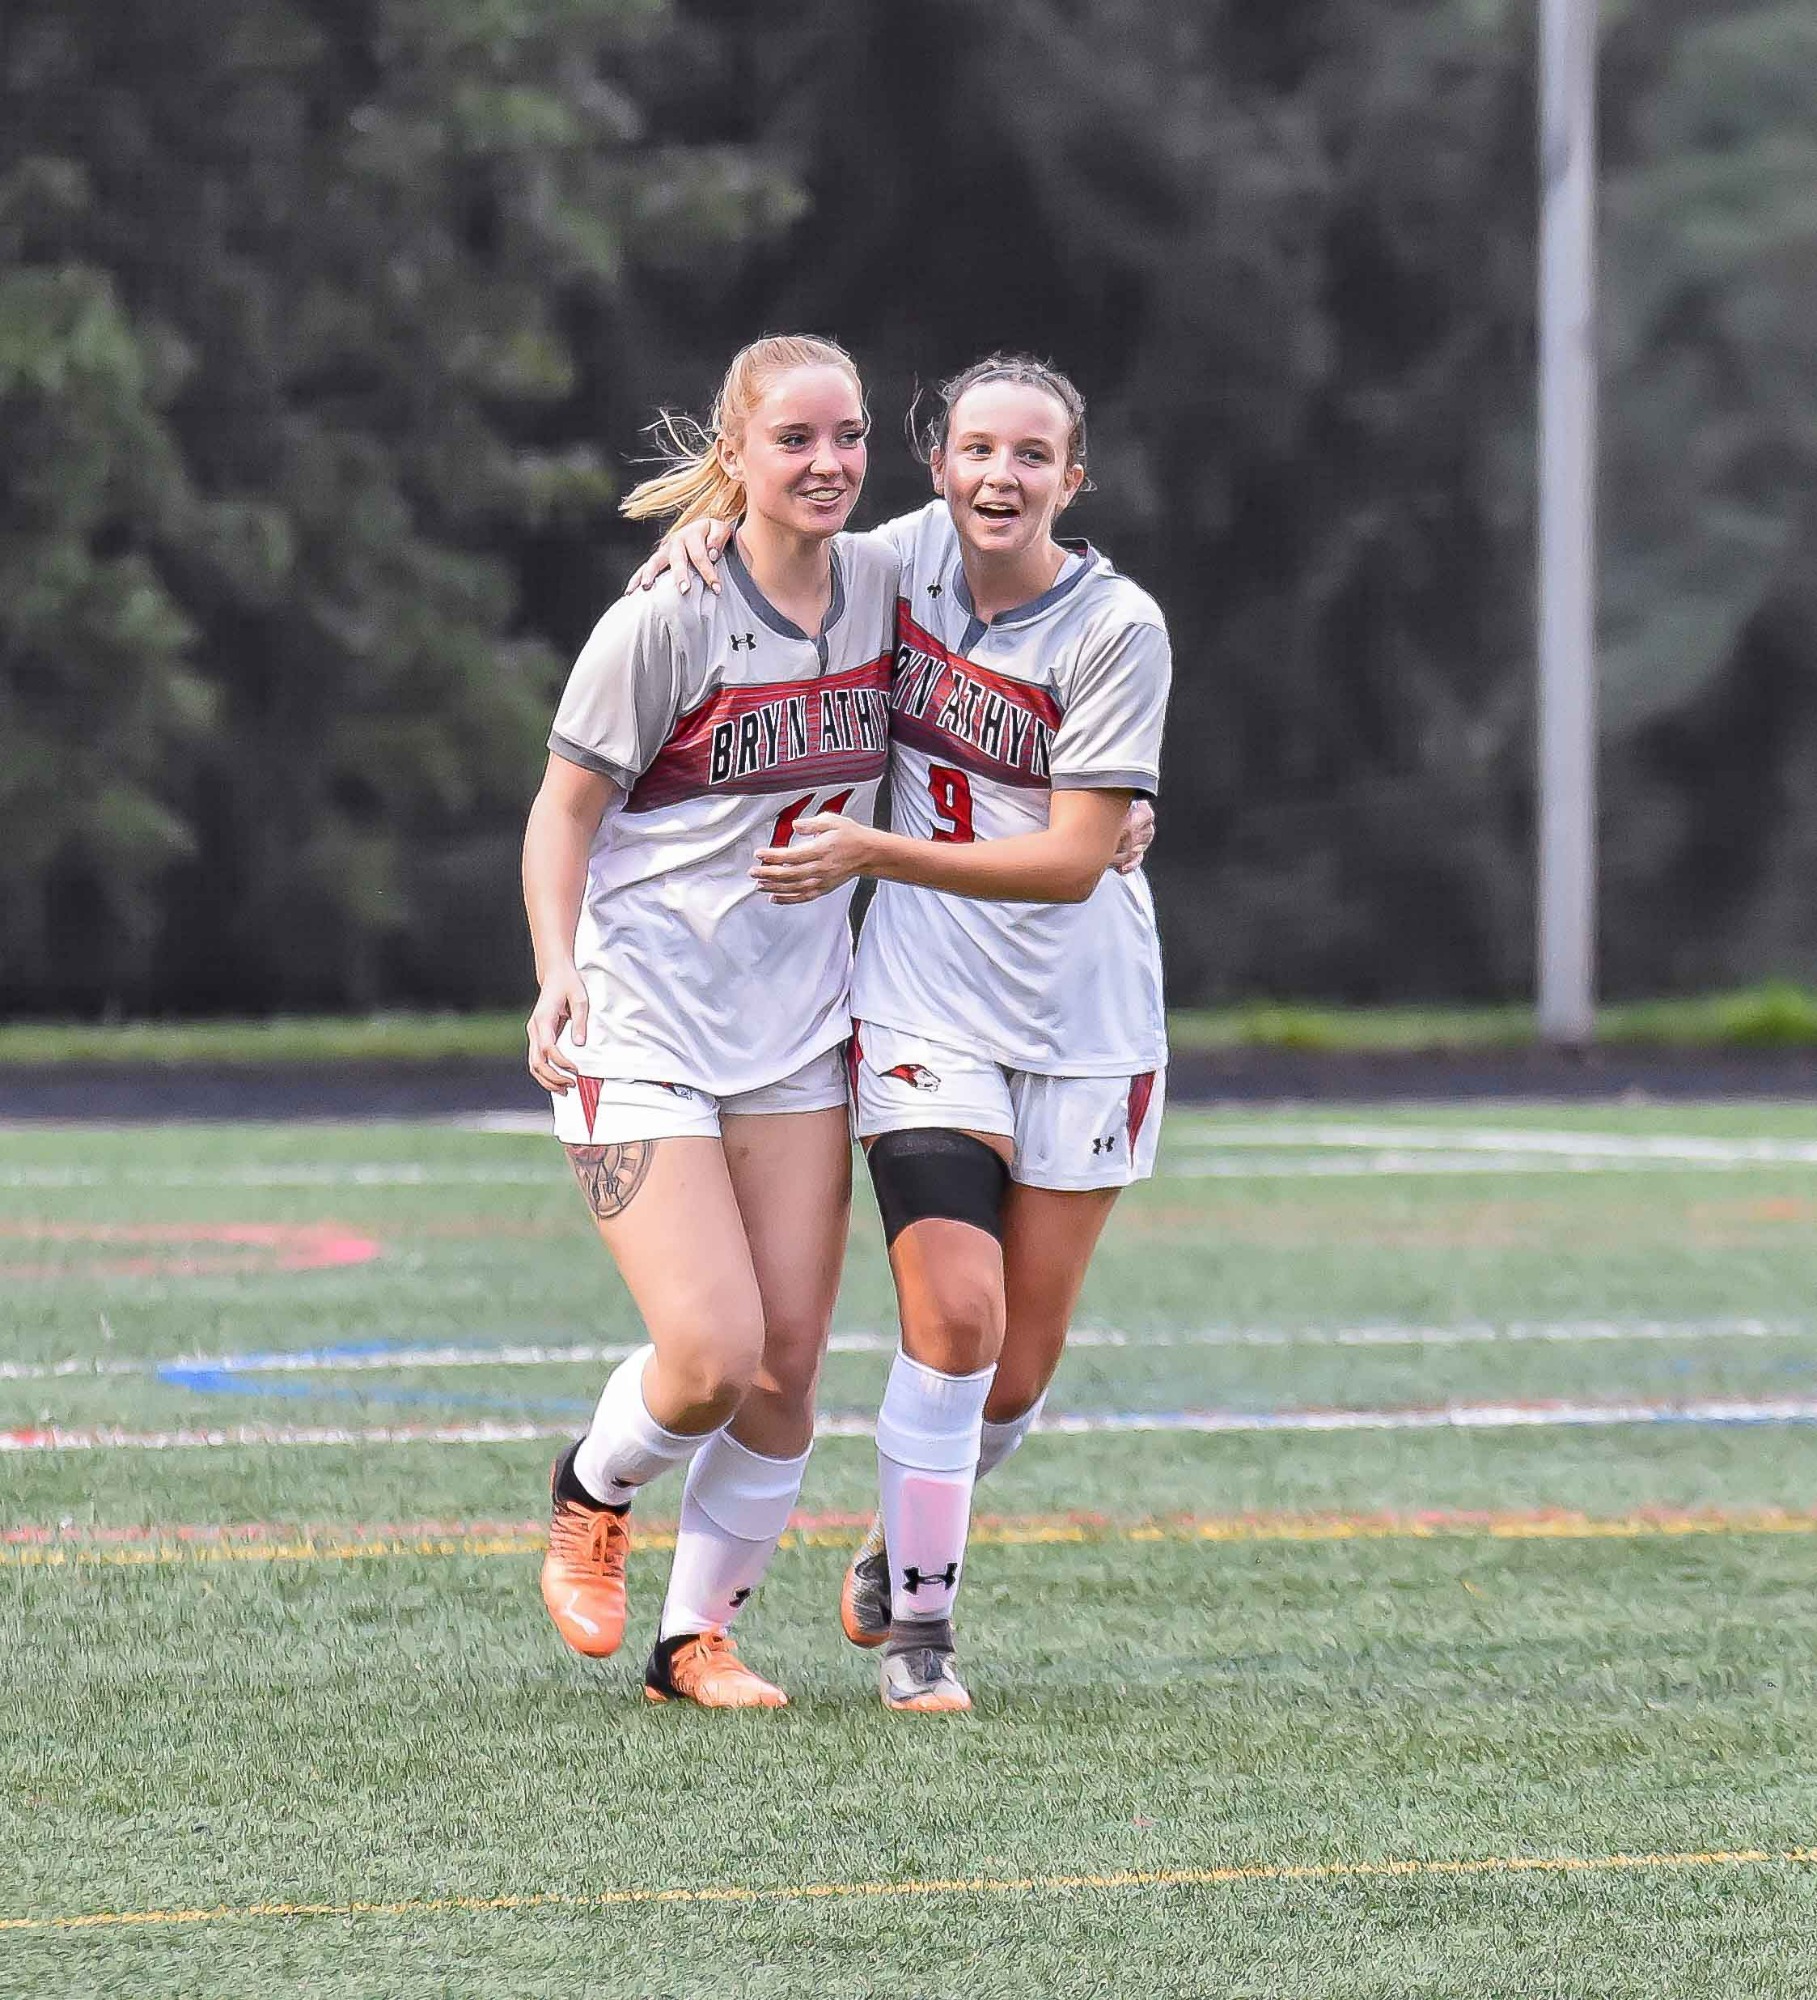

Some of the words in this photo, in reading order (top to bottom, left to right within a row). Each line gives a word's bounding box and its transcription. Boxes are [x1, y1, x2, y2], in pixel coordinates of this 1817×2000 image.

[708, 694, 807, 786] BRYN
[935, 667, 1056, 779] ATHYN
[927, 763, 976, 843] 9
